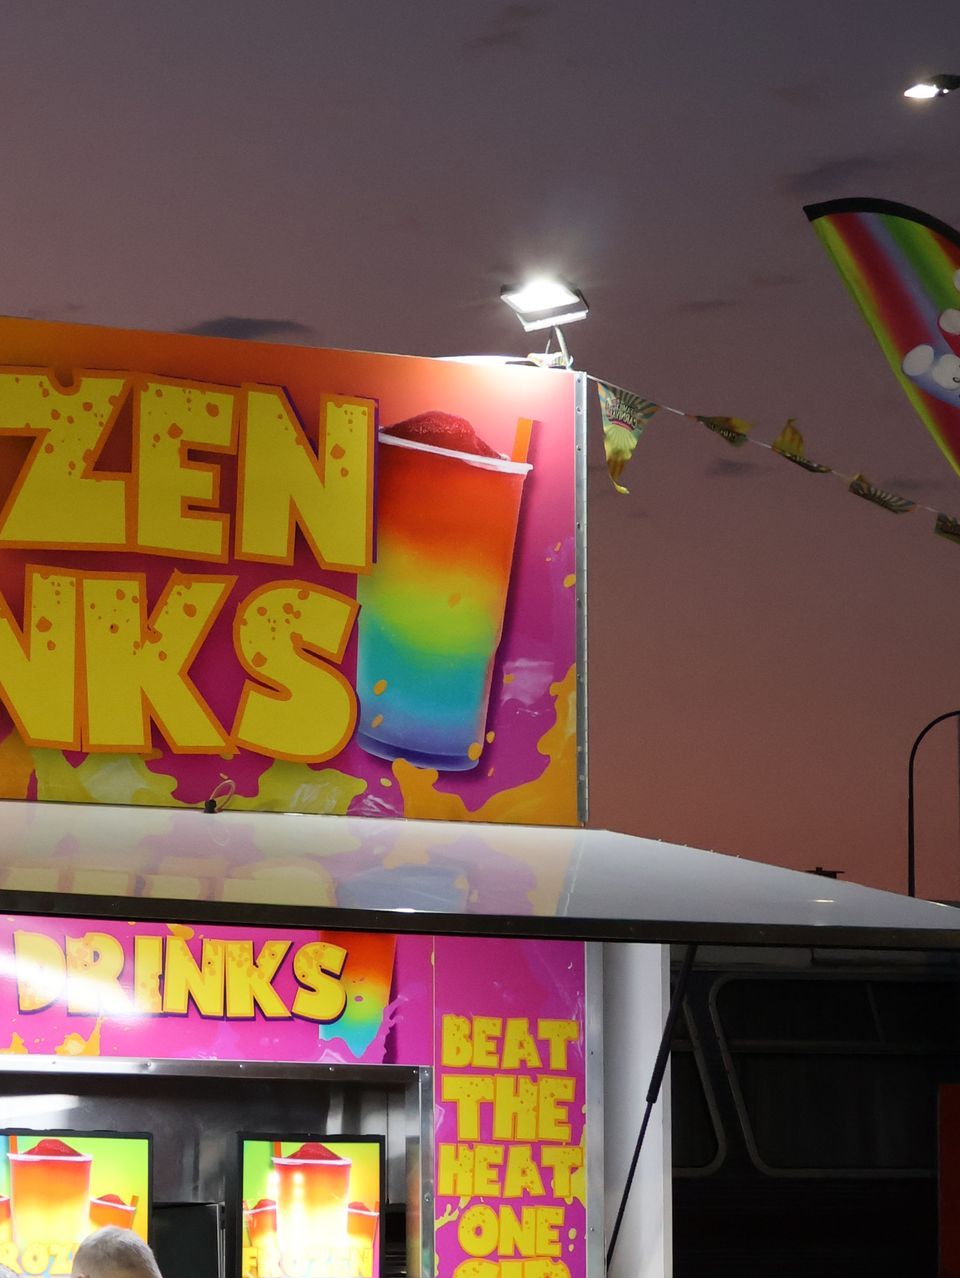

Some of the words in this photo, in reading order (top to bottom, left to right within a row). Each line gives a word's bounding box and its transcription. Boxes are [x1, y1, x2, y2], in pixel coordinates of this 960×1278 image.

[14, 931, 348, 1023] DRINKS
[441, 1013, 579, 1070] BEAT
[441, 1073, 577, 1141] THE
[438, 1143, 583, 1198] HEAT
[456, 1203, 566, 1258] ONE
